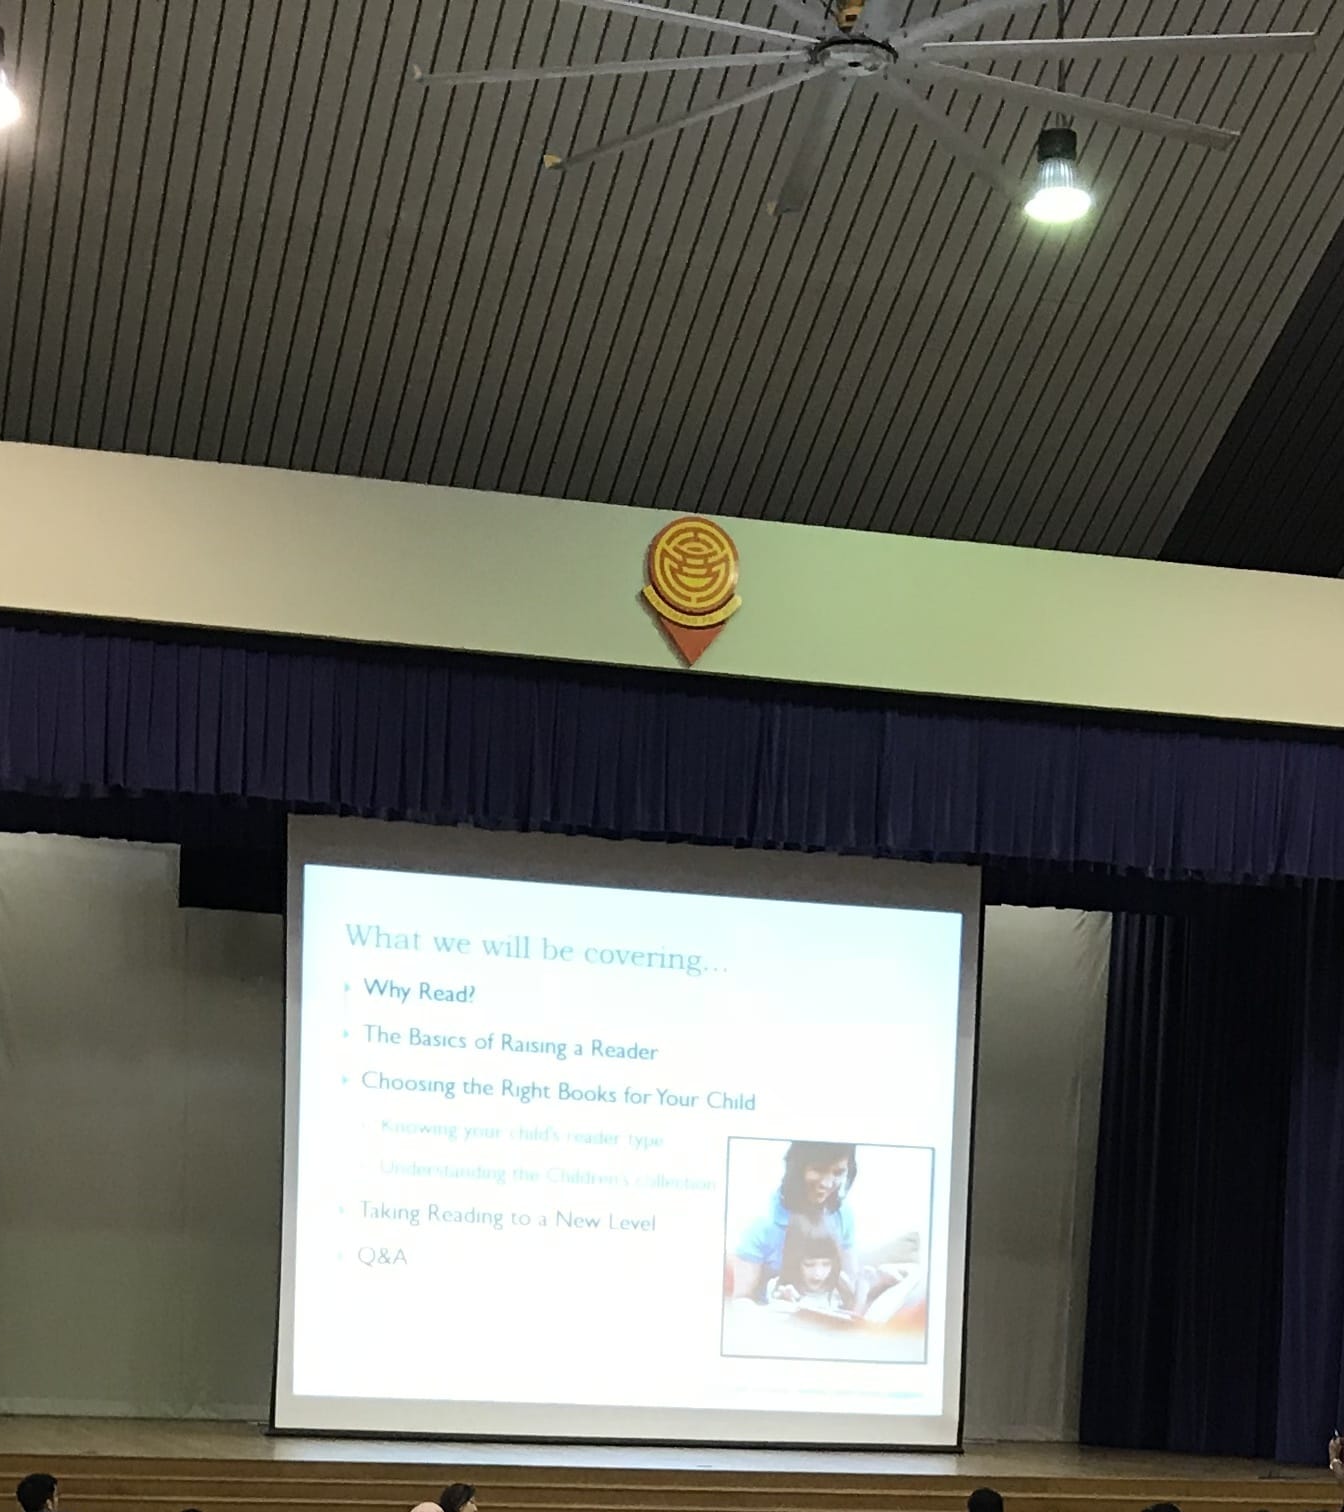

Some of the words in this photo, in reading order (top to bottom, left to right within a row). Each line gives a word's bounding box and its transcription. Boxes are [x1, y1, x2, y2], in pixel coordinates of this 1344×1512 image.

[346, 922, 420, 951] What
[433, 935, 471, 954] we
[483, 935, 531, 960] will
[543, 937, 574, 962] be
[364, 977, 410, 1004] Why
[419, 982, 475, 1004] Read?
[363, 1024, 401, 1044] The
[409, 1027, 467, 1049] Basics
[474, 1033, 495, 1050] of
[502, 1033, 567, 1060] Raising
[574, 1043, 584, 1056] a
[591, 1039, 659, 1061] Reader
[361, 1071, 456, 1099] Choosing
[463, 1077, 494, 1097] the
[502, 1079, 551, 1103] Right
[558, 1082, 617, 1104] Books
[624, 1085, 652, 1105] for
[655, 1087, 699, 1108] Your
[707, 1091, 756, 1111] Child
[360, 1200, 420, 1225] Taking
[428, 1204, 503, 1231] Reading
[512, 1212, 531, 1227] to
[539, 1214, 548, 1227] a
[556, 1211, 601, 1230] New
[609, 1212, 656, 1232] Level
[357, 1245, 407, 1268] Q&A
